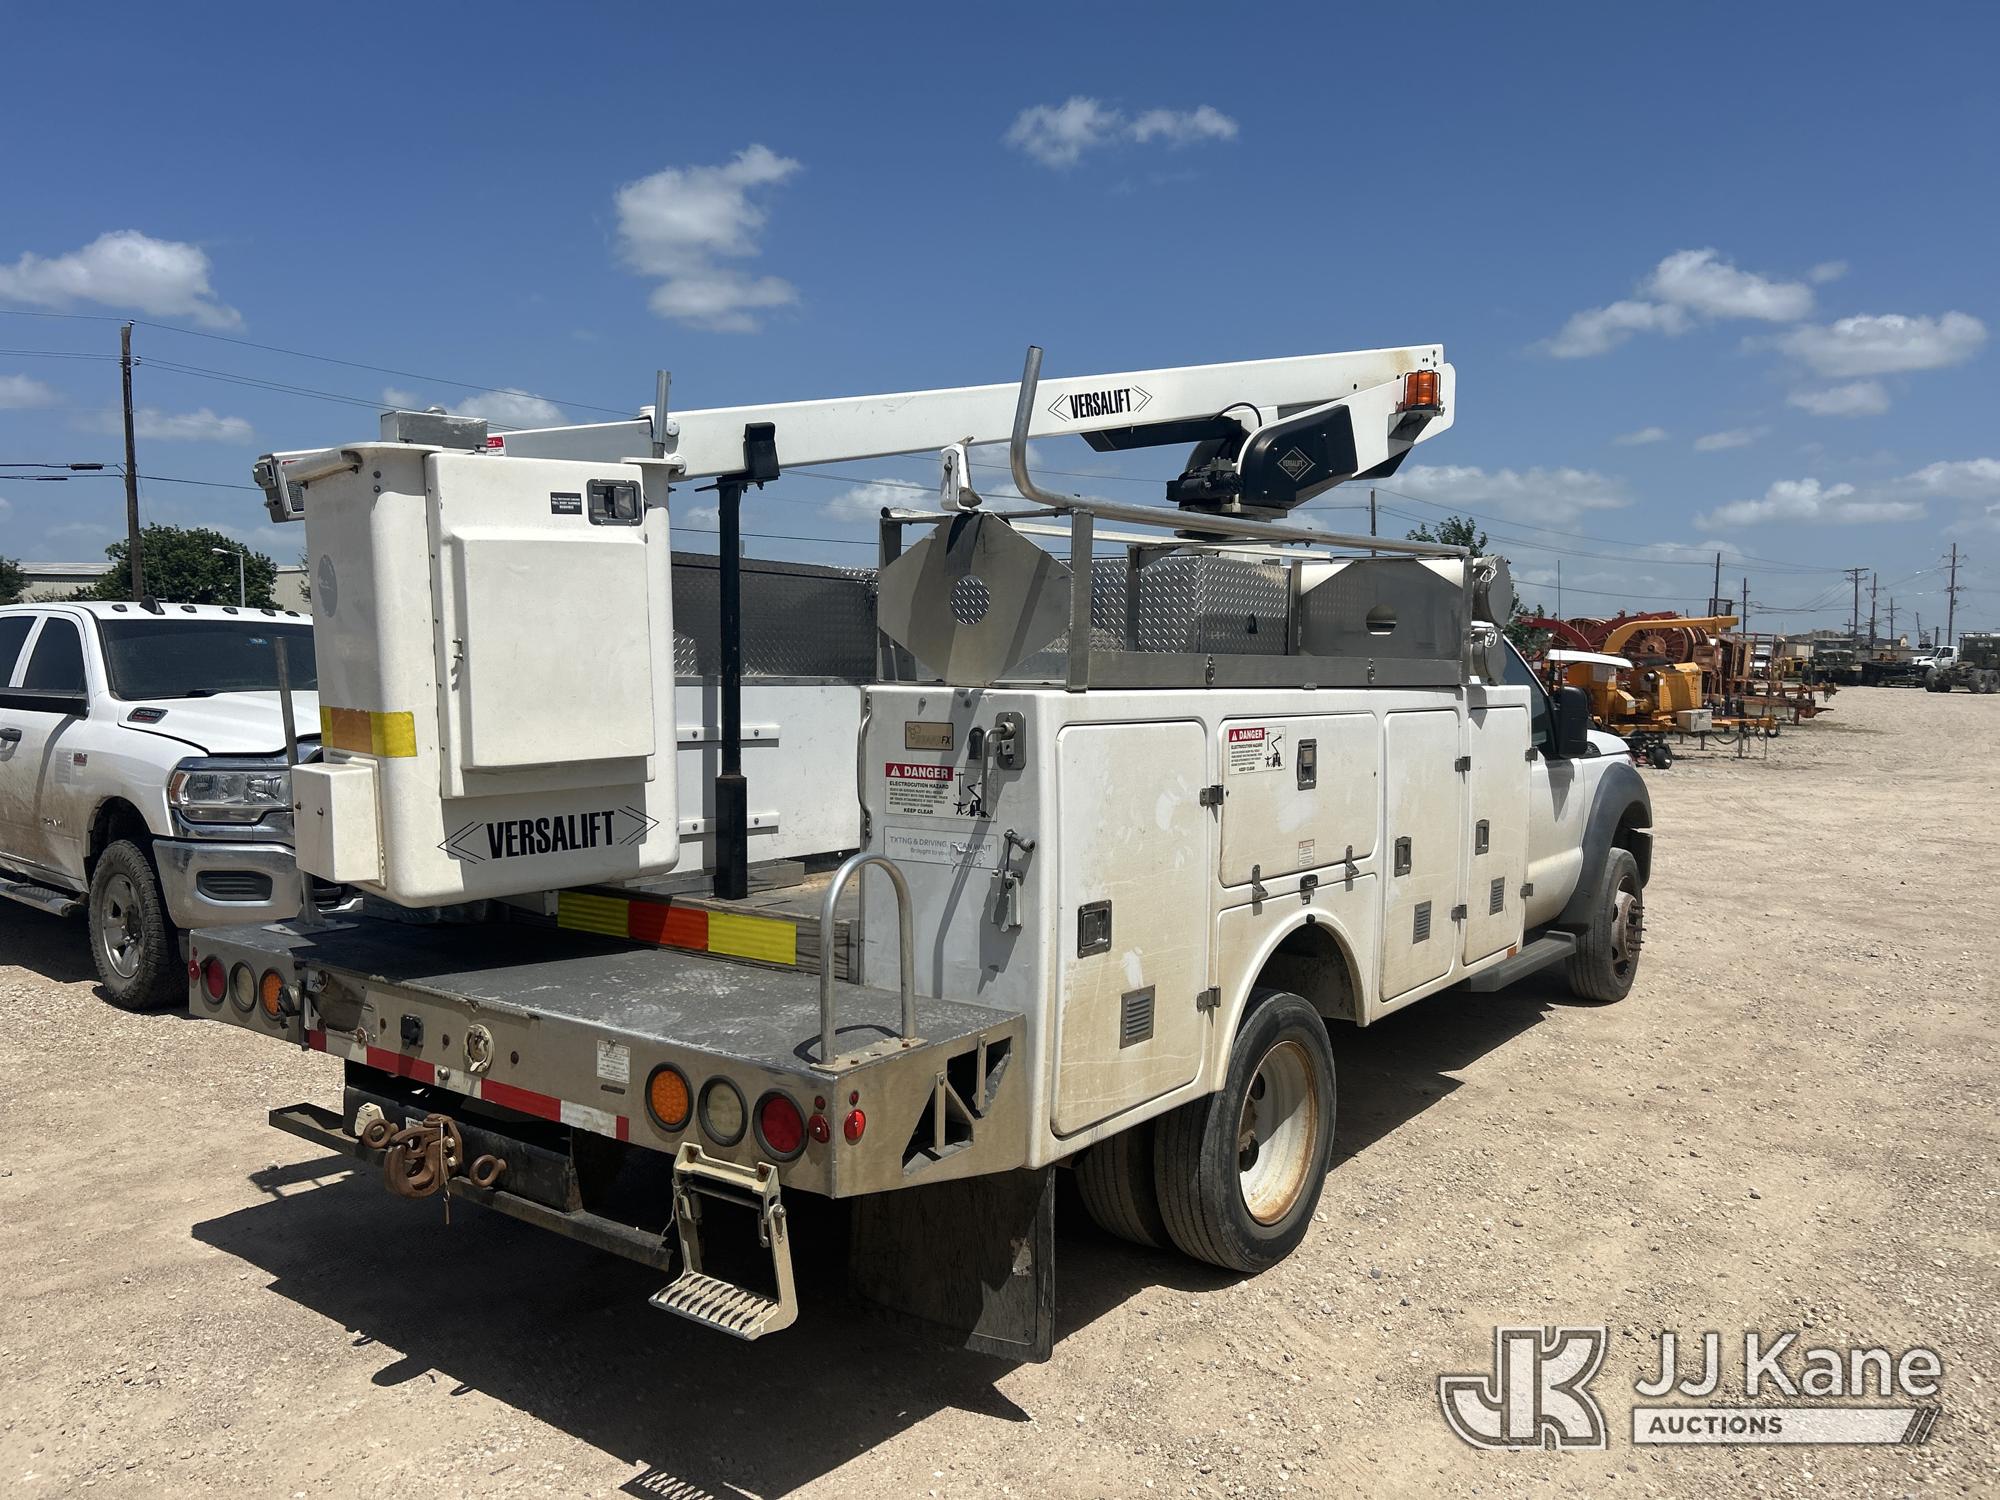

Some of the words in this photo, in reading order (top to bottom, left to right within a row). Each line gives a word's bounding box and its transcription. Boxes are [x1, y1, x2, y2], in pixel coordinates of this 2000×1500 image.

[1069, 388, 1131, 419] VERSALIFT
[1238, 729, 1263, 740] DANGER
[904, 765, 948, 779] DANGER
[889, 780, 928, 788] ELECTROCUTION
[486, 810, 615, 859] VERSALIFT
[889, 835, 912, 846] TXTNG
[919, 838, 947, 847] DRIVING
